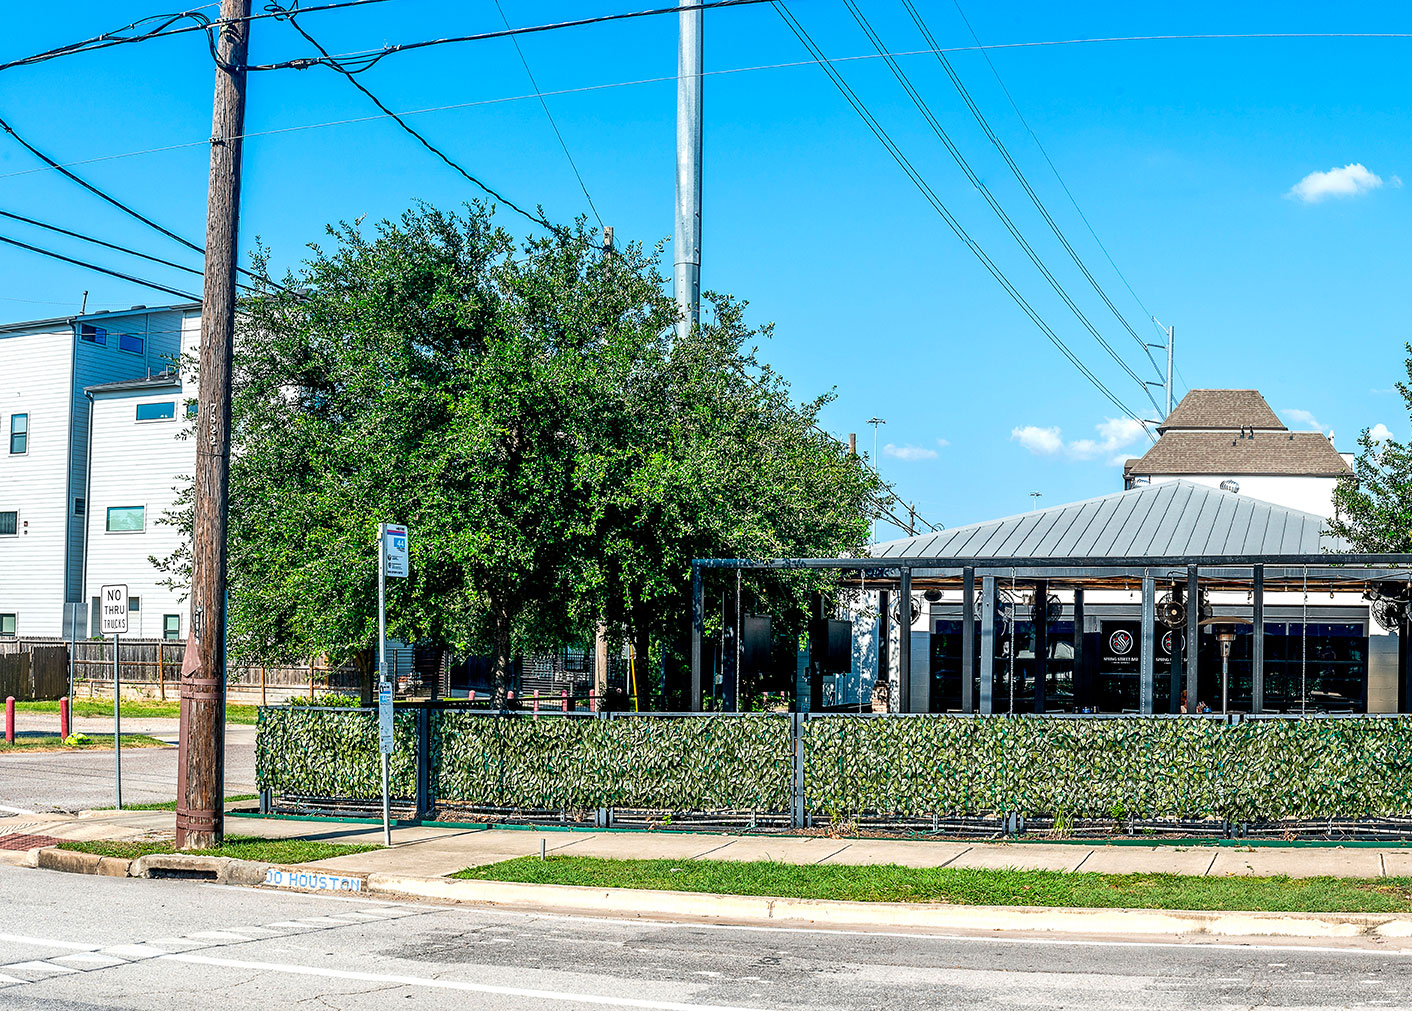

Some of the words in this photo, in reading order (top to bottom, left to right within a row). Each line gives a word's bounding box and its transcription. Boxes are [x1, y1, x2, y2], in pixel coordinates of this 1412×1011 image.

[107, 589, 121, 601] NO
[104, 605, 125, 615] THRU
[104, 619, 125, 629] TRUCKS
[289, 872, 360, 892] HOUSTON
